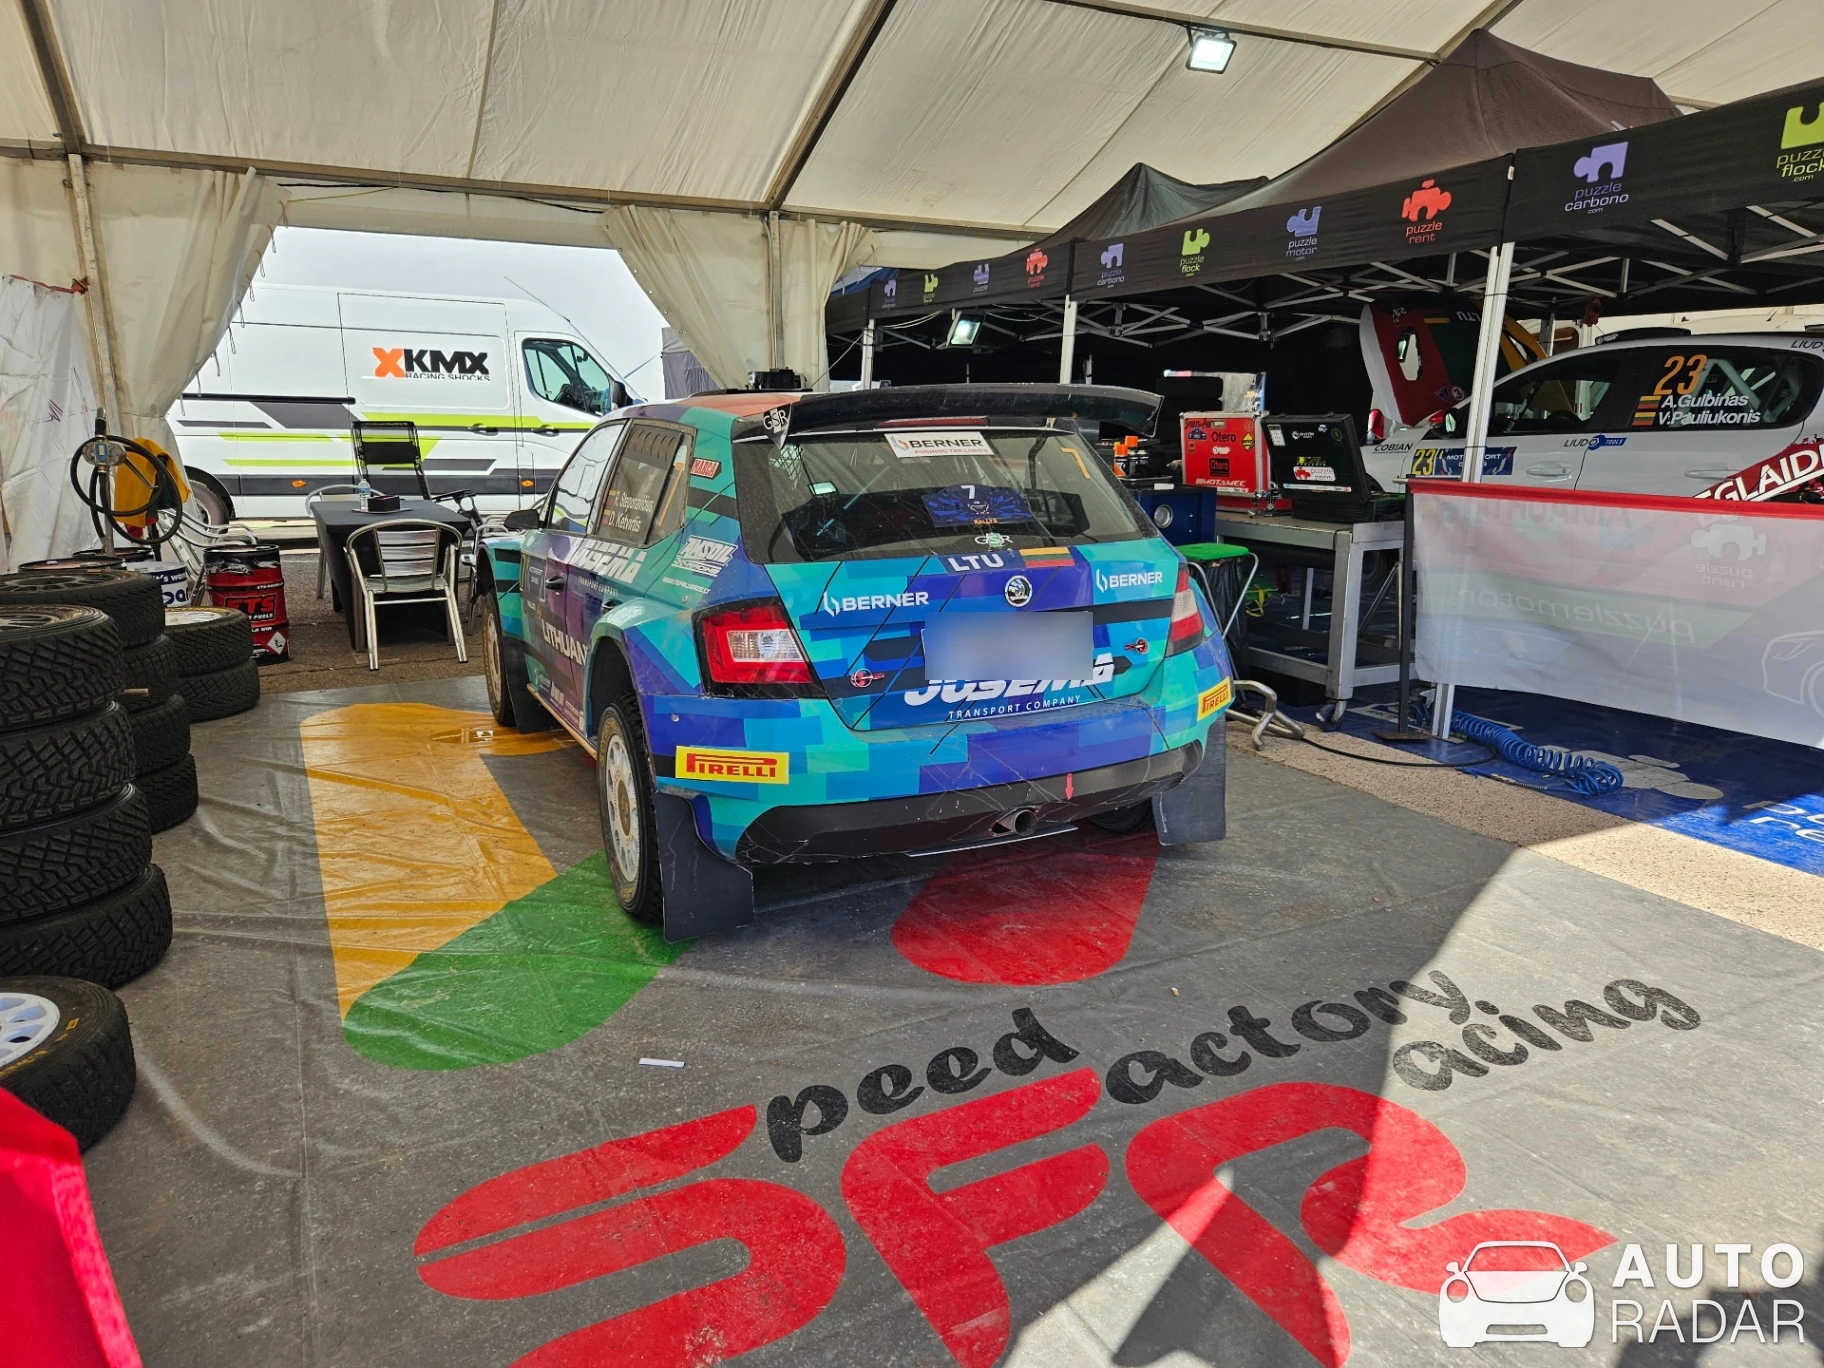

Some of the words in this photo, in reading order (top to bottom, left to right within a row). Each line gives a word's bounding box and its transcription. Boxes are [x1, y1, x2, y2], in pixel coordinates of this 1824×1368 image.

[1776, 149, 1824, 169] puzz
[1574, 181, 1623, 200] puzzle
[1564, 193, 1629, 212] carbono
[1405, 219, 1443, 236] puzzle
[1288, 236, 1318, 248] puzzle
[1408, 231, 1437, 244] rent
[1285, 246, 1318, 258] motor
[1179, 255, 1205, 268] puzzle
[1182, 264, 1201, 274] flock
[1096, 275, 1125, 286] carbono
[1101, 268, 1122, 279] puzzle
[1791, 340, 1824, 349] LIUD
[1652, 353, 1708, 396] 23
[1660, 394, 1750, 409] A.Gulbinas
[763, 409, 789, 431] GSR
[1658, 410, 1761, 426] V.Pauliukonis
[908, 439, 984, 448] BERNER
[1211, 431, 1237, 442] Otero
[1605, 438, 1624, 446] TOOLS
[1374, 443, 1413, 452] COBIAN
[1210, 459, 1229, 470] Otero
[1411, 448, 1436, 476] 23
[1202, 479, 1247, 487] MOTAMEC
[960, 484, 977, 500] 7
[947, 553, 1005, 573] LTU
[1109, 570, 1163, 588] BERNER
[841, 591, 930, 612] BERNER
[1201, 683, 1230, 714] PIRELLI
[948, 704, 1020, 720] TRANSPORT
[1025, 694, 1082, 711] COMPANY
[686, 752, 778, 778] PIRELLI
[767, 1006, 1081, 1163] peed
